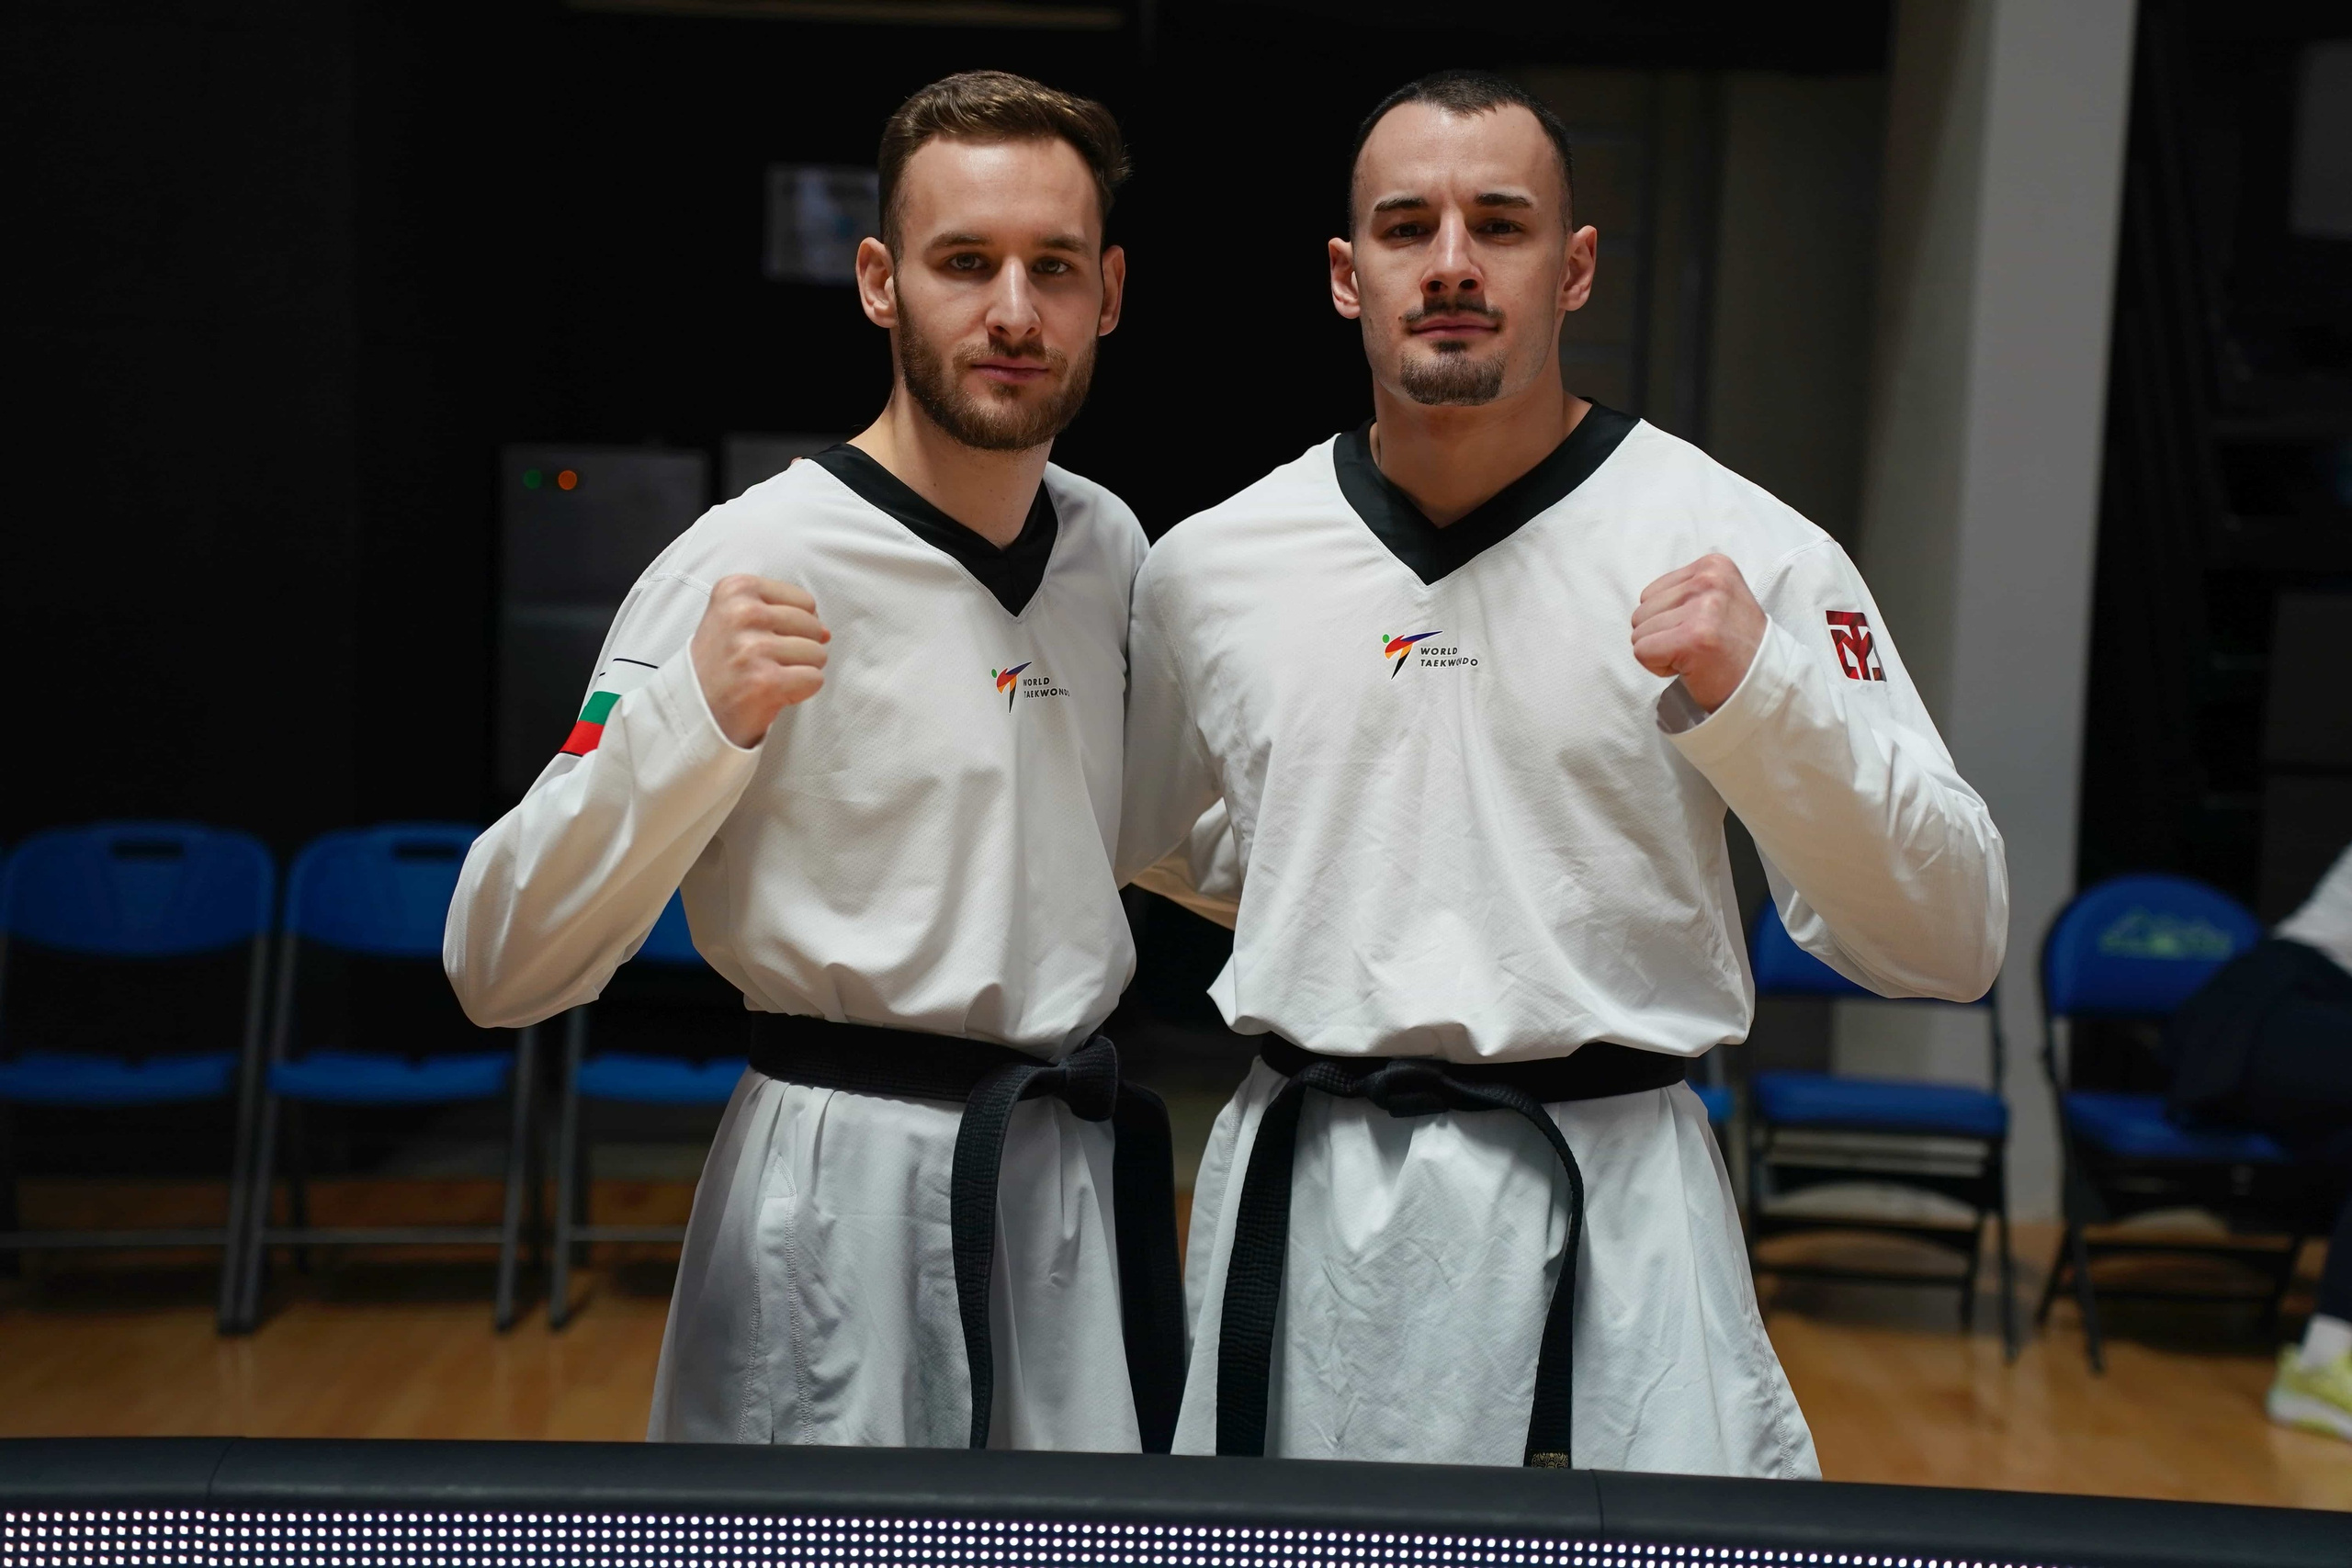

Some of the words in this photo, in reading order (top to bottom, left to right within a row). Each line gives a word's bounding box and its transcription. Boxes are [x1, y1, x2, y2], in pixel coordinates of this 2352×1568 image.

[1420, 648, 1458, 656] WORLD
[1023, 677, 1050, 686] WORLD
[1023, 688, 1070, 698] TAEKWON
